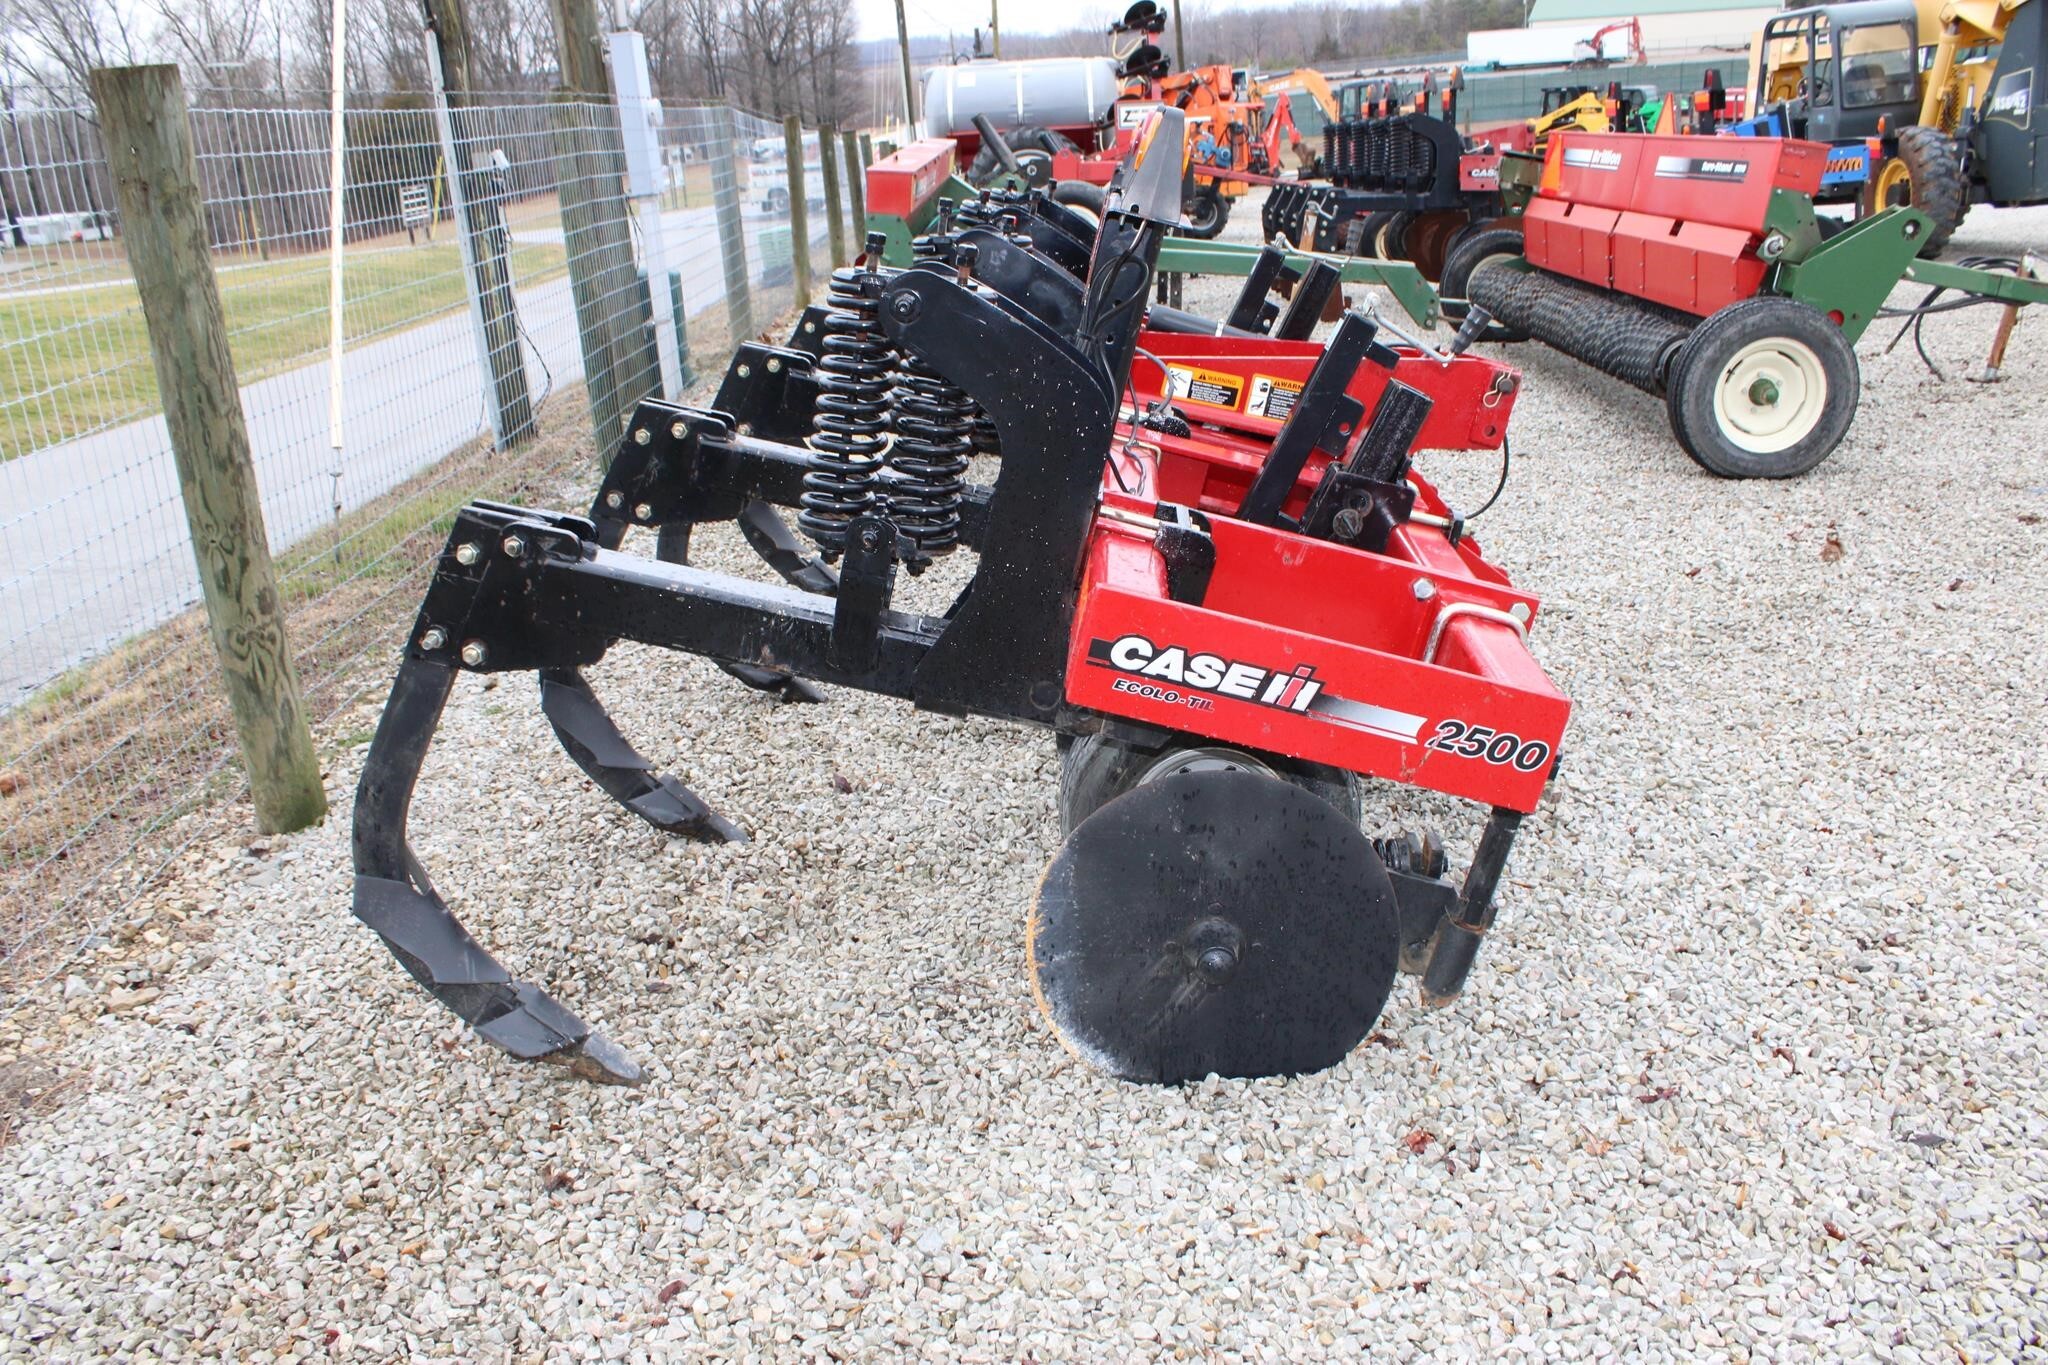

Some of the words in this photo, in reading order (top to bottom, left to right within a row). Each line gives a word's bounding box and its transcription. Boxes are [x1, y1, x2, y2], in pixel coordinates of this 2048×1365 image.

[1207, 374, 1238, 386] WARNING
[1279, 380, 1303, 391] WARN
[1110, 637, 1267, 699] CASE
[1424, 719, 1551, 773] 2500
